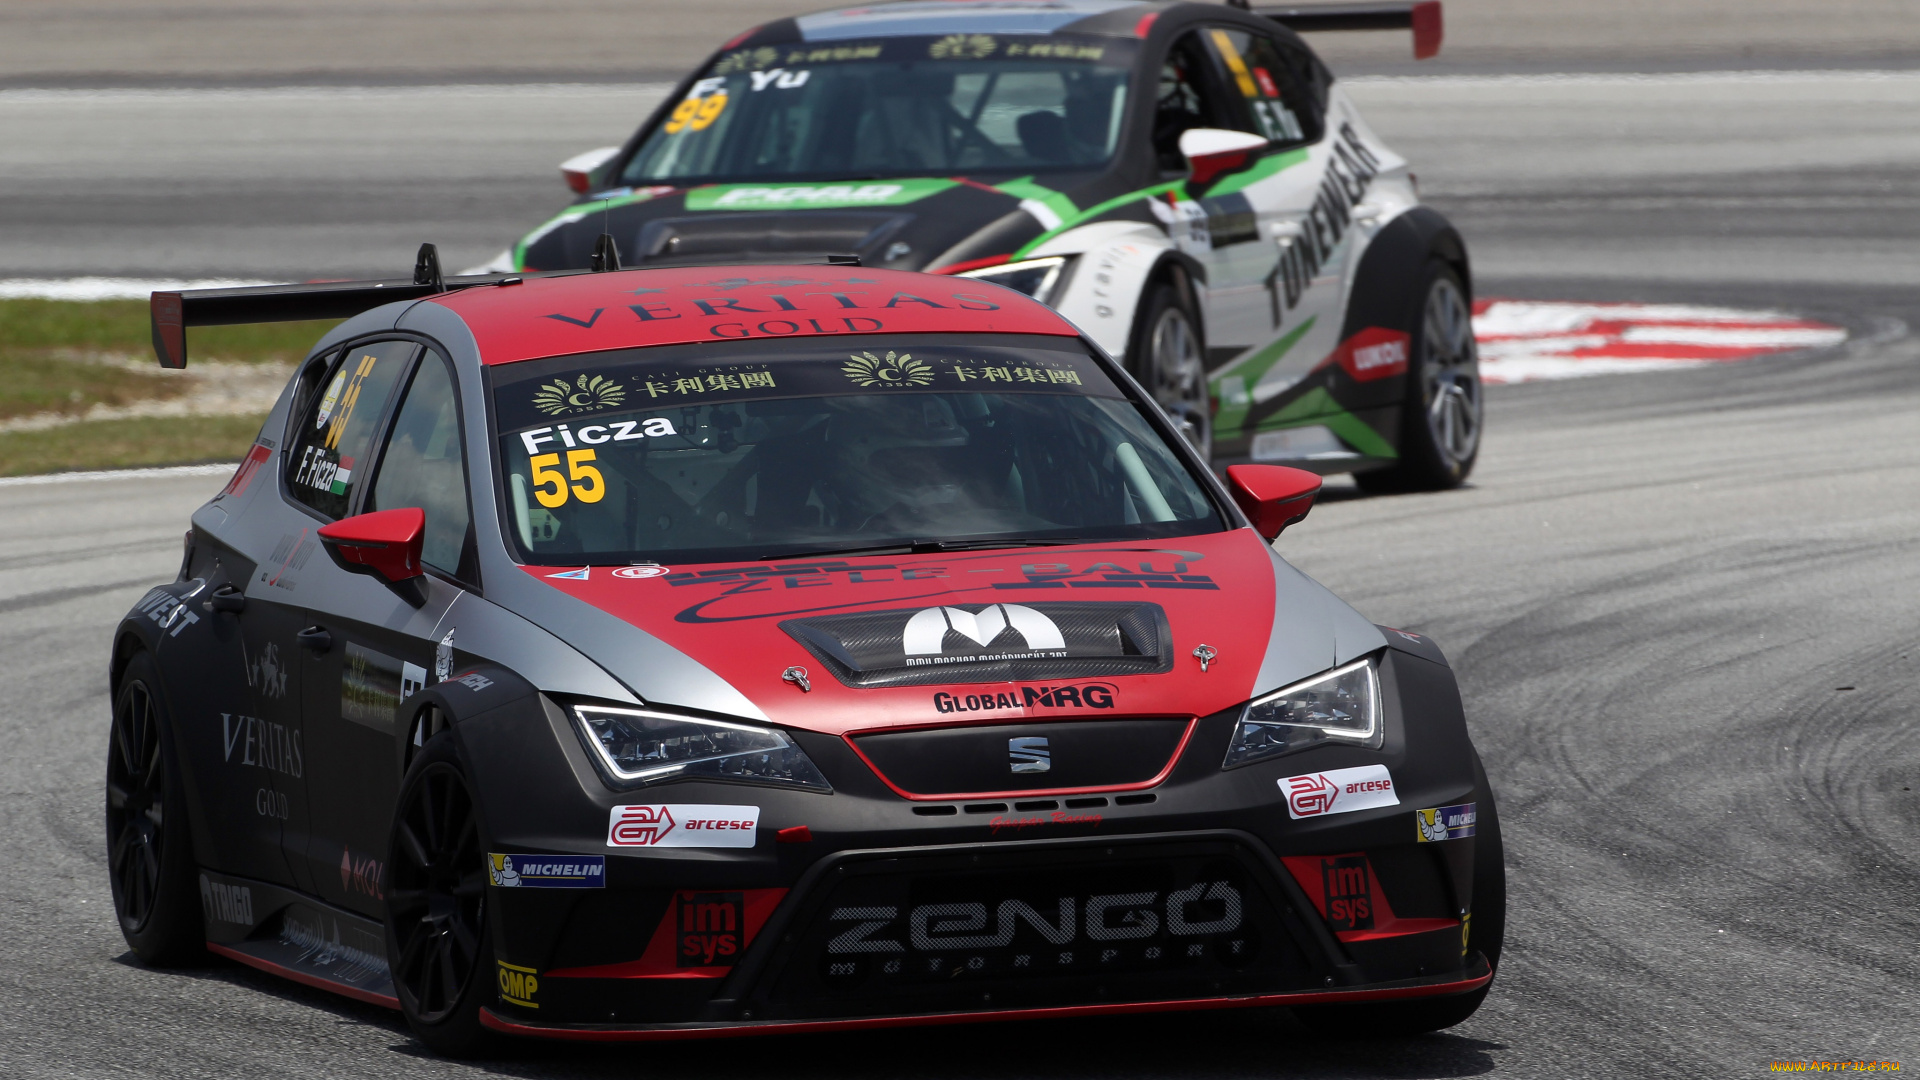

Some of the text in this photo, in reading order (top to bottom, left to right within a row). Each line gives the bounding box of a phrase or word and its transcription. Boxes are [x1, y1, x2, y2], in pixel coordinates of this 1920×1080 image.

[686, 68, 811, 99] F. Yu
[664, 93, 729, 134] 99
[544, 291, 1001, 329] VERITAS
[709, 317, 884, 338] GOLD
[632, 364, 768, 381] CALI GROUP
[945, 365, 1082, 386] 卡利集團
[1006, 360, 1073, 368] GROUP
[636, 371, 776, 398] 卡利集團
[325, 355, 377, 450] 55
[568, 404, 603, 414] 1356
[519, 417, 677, 455] Ficza
[296, 445, 313, 484] F.
[305, 449, 338, 492] Ficza
[530, 448, 606, 508] 55
[220, 712, 302, 779] VERITAS
[1346, 778, 1391, 794] arcese
[256, 788, 288, 820] GOLD
[685, 817, 755, 831] arcese
[1050, 811, 1103, 828] Racing
[353, 858, 384, 900] MOL
[522, 863, 602, 876] MICHELIN
[211, 881, 254, 926] TRIGO
[1331, 898, 1369, 928] sys
[683, 932, 737, 964] sys
[500, 971, 539, 1000] OMP
